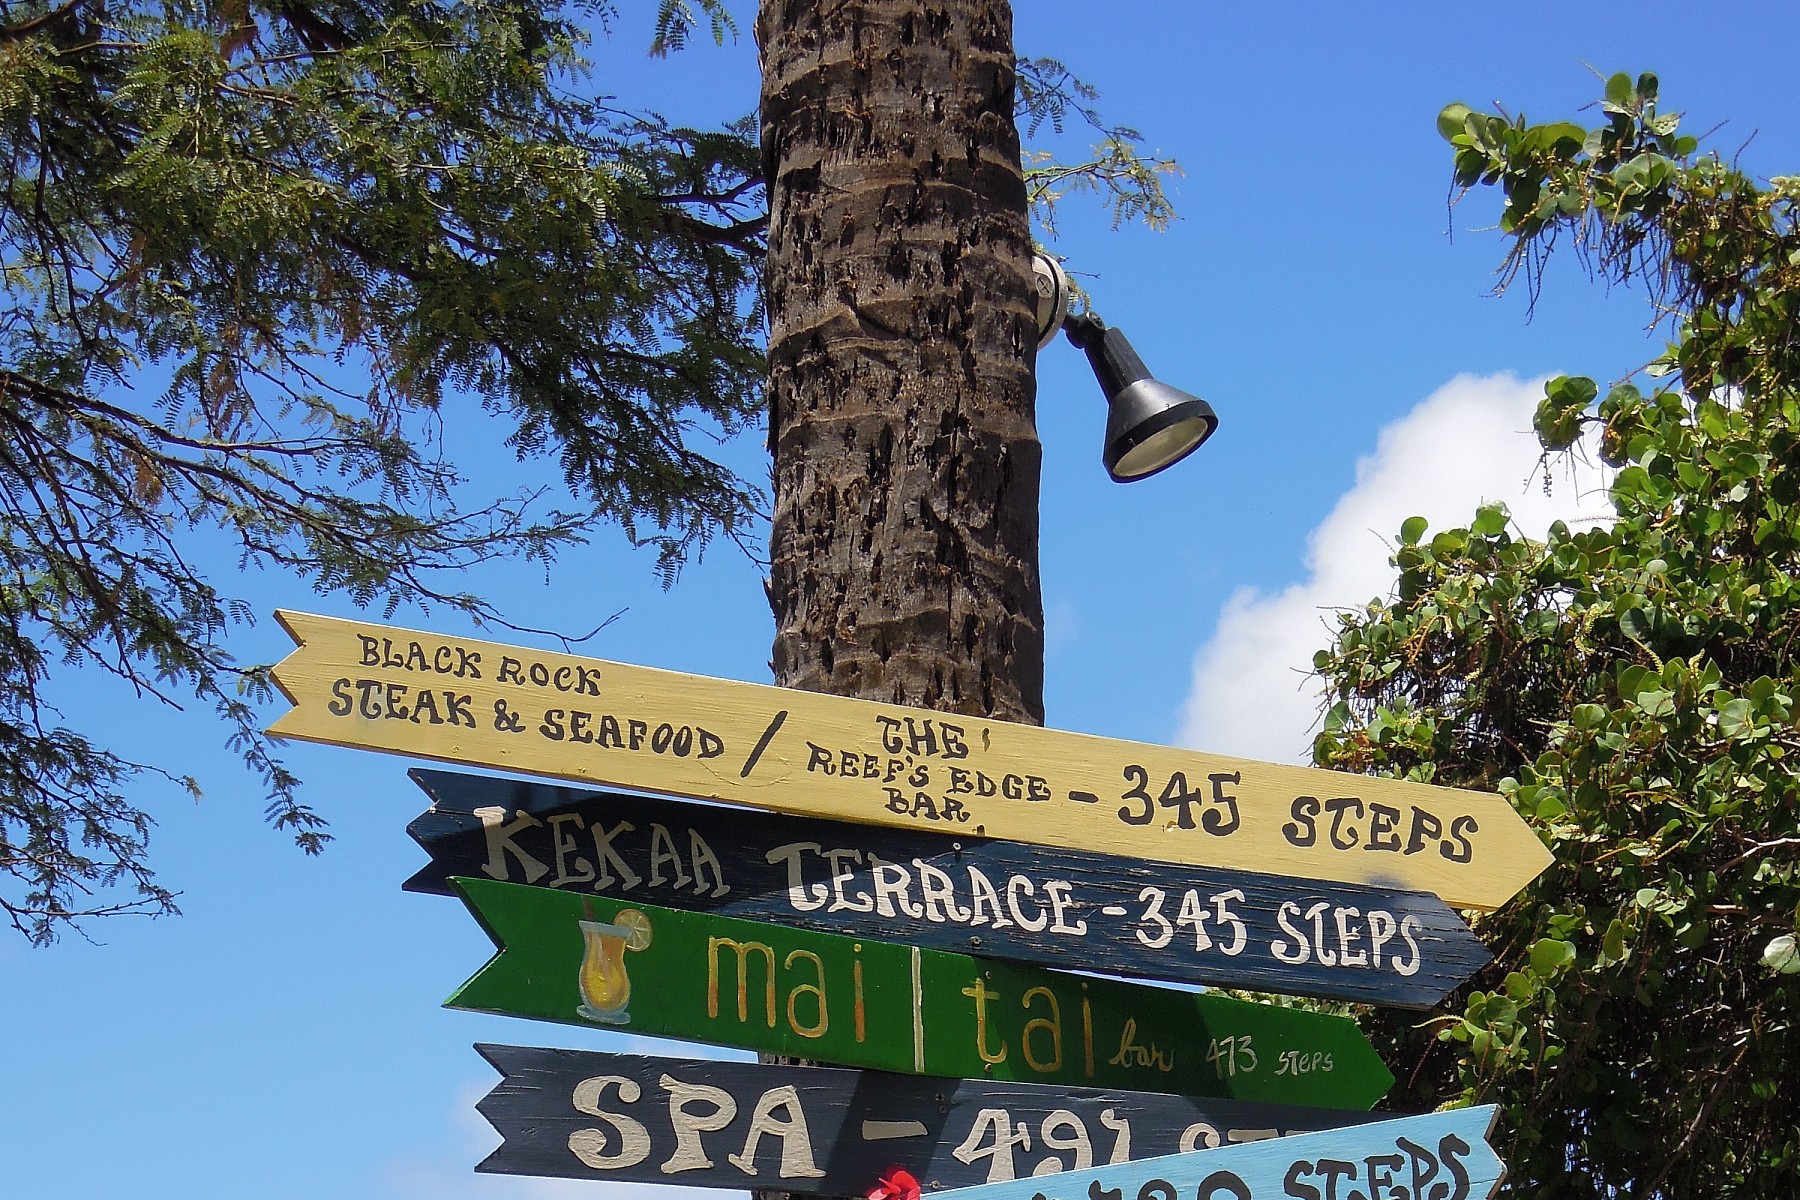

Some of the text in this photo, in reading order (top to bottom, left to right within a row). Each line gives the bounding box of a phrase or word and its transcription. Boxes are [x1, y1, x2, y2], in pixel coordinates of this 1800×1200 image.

[356, 634, 601, 697] BLACK ROCK
[328, 677, 476, 729] STEAK
[493, 698, 525, 733] &
[539, 708, 724, 760] SEAFOOD
[876, 715, 969, 759] THE
[805, 741, 929, 787] REEF'S
[946, 766, 1051, 801] EDGE
[1118, 765, 1242, 837] 345
[1282, 796, 1480, 864] STEPS
[882, 787, 970, 822] BAR
[472, 805, 730, 897] KEKAA
[765, 841, 1087, 936] TERRACE
[1135, 886, 1246, 956] 345
[1270, 900, 1423, 976] STEPS
[707, 935, 866, 1043] mai
[962, 977, 1093, 1077] tai
[1108, 1018, 1174, 1072] bar
[1205, 1035, 1258, 1080] 473
[567, 1072, 827, 1179] SPA
